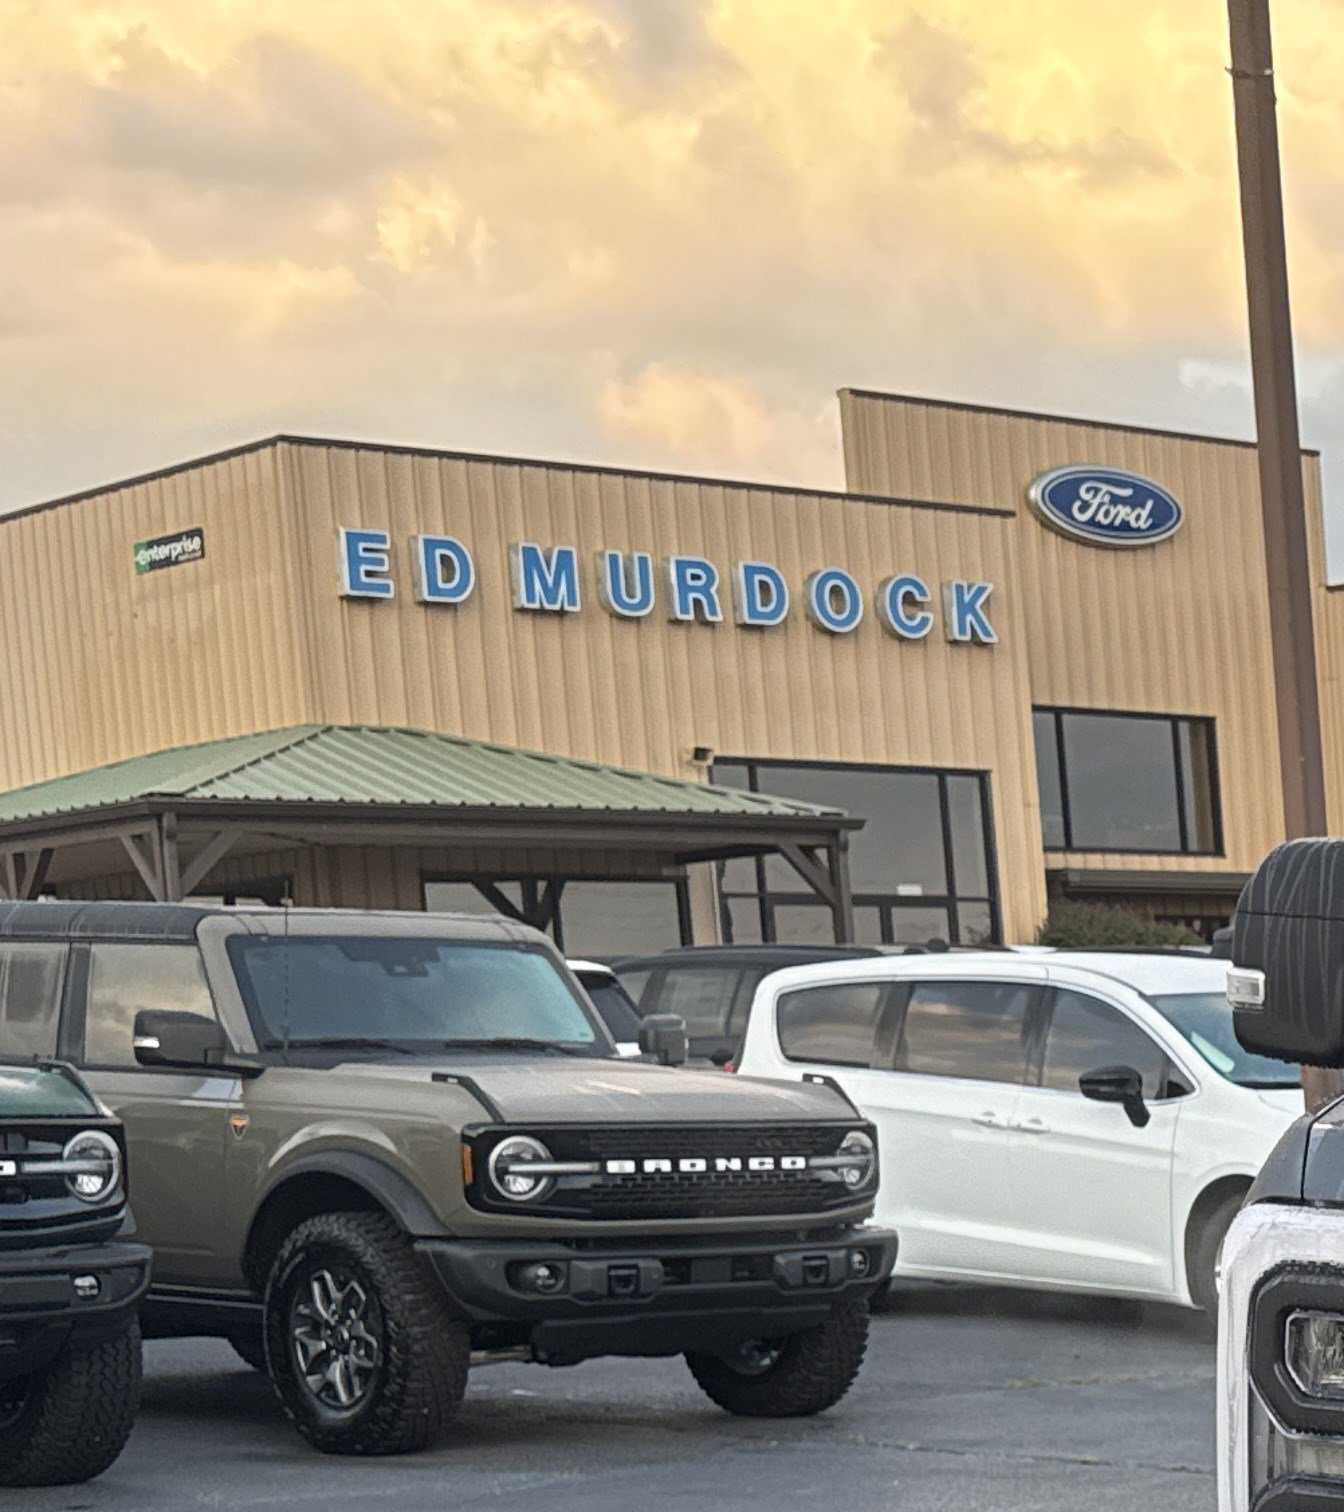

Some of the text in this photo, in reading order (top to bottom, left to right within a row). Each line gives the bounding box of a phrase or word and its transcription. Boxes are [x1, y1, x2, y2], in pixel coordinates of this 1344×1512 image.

[1072, 480, 1154, 530] Ford
[337, 525, 999, 645] ED MURDOCK
[606, 1156, 806, 1174] BRONCO
